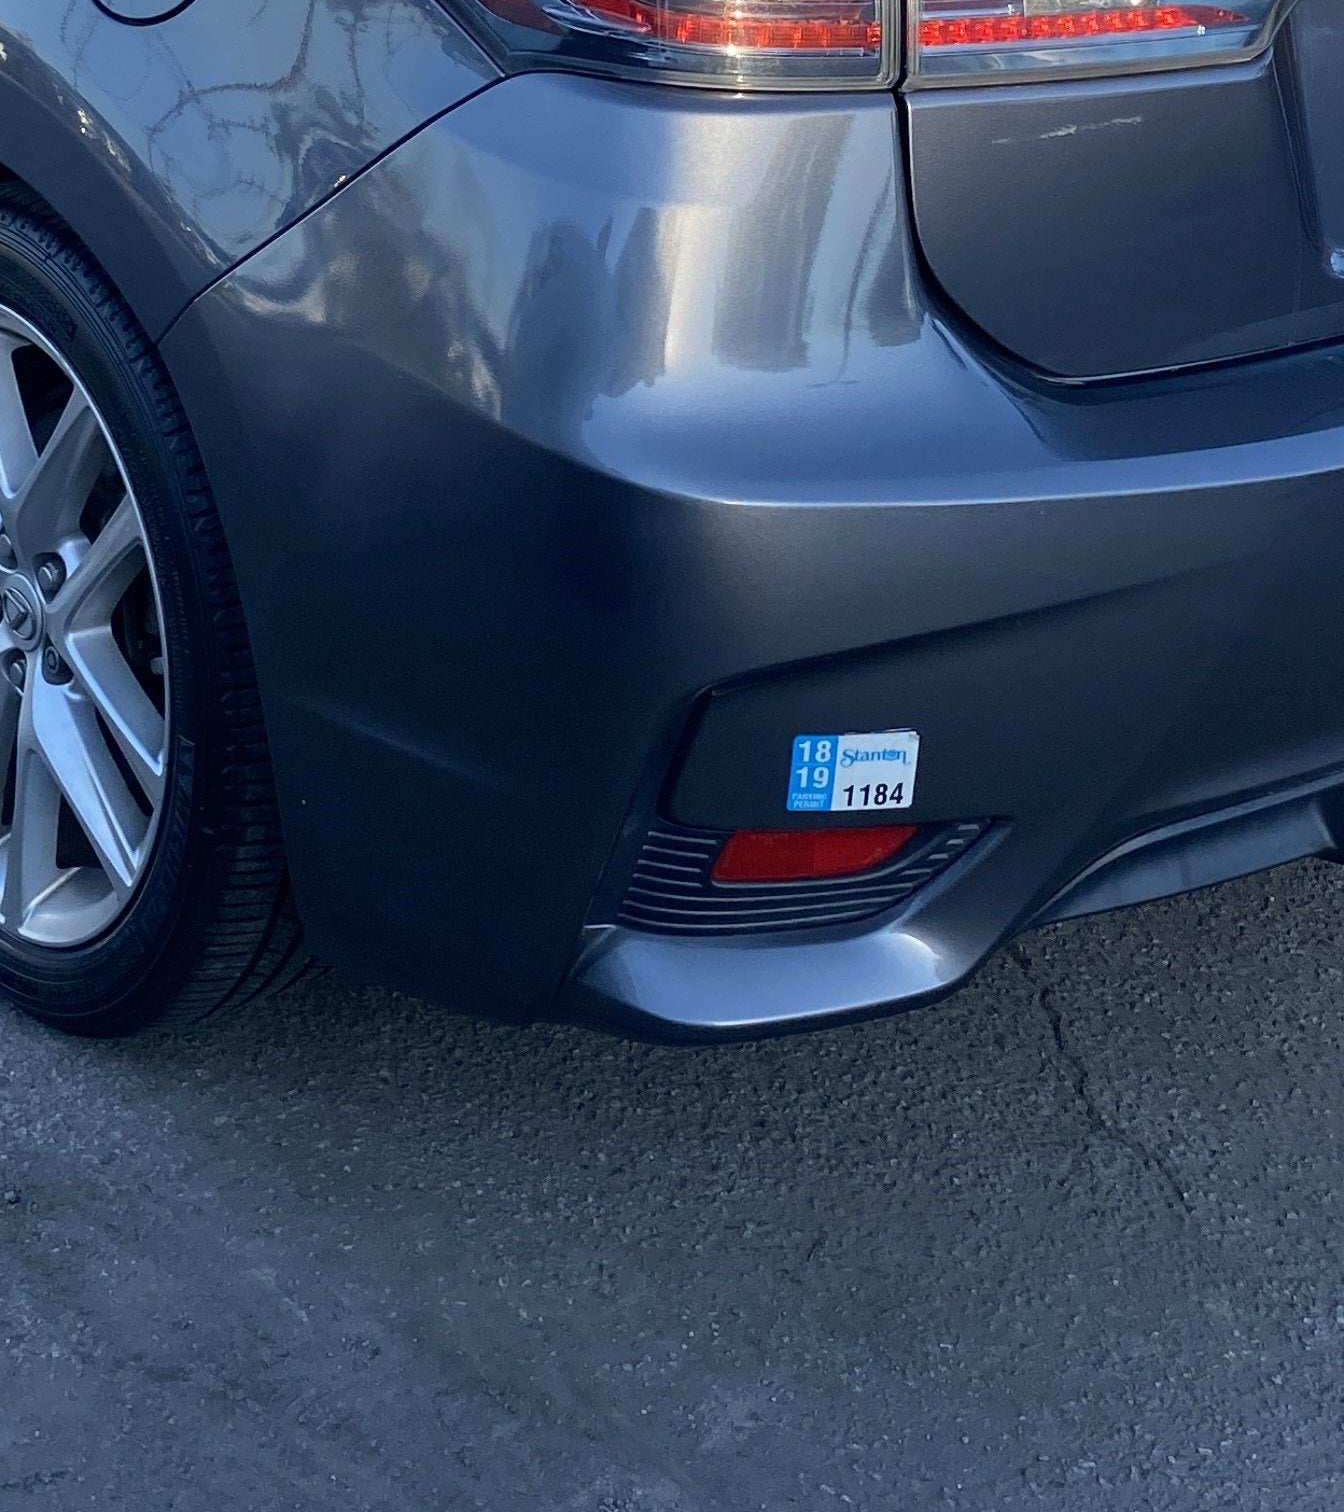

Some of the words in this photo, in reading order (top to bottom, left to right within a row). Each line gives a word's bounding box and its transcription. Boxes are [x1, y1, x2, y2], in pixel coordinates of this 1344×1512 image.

[798, 740, 832, 763] 18
[840, 748, 912, 769] Stanton
[796, 766, 830, 788] 19
[843, 782, 904, 807] 1184
